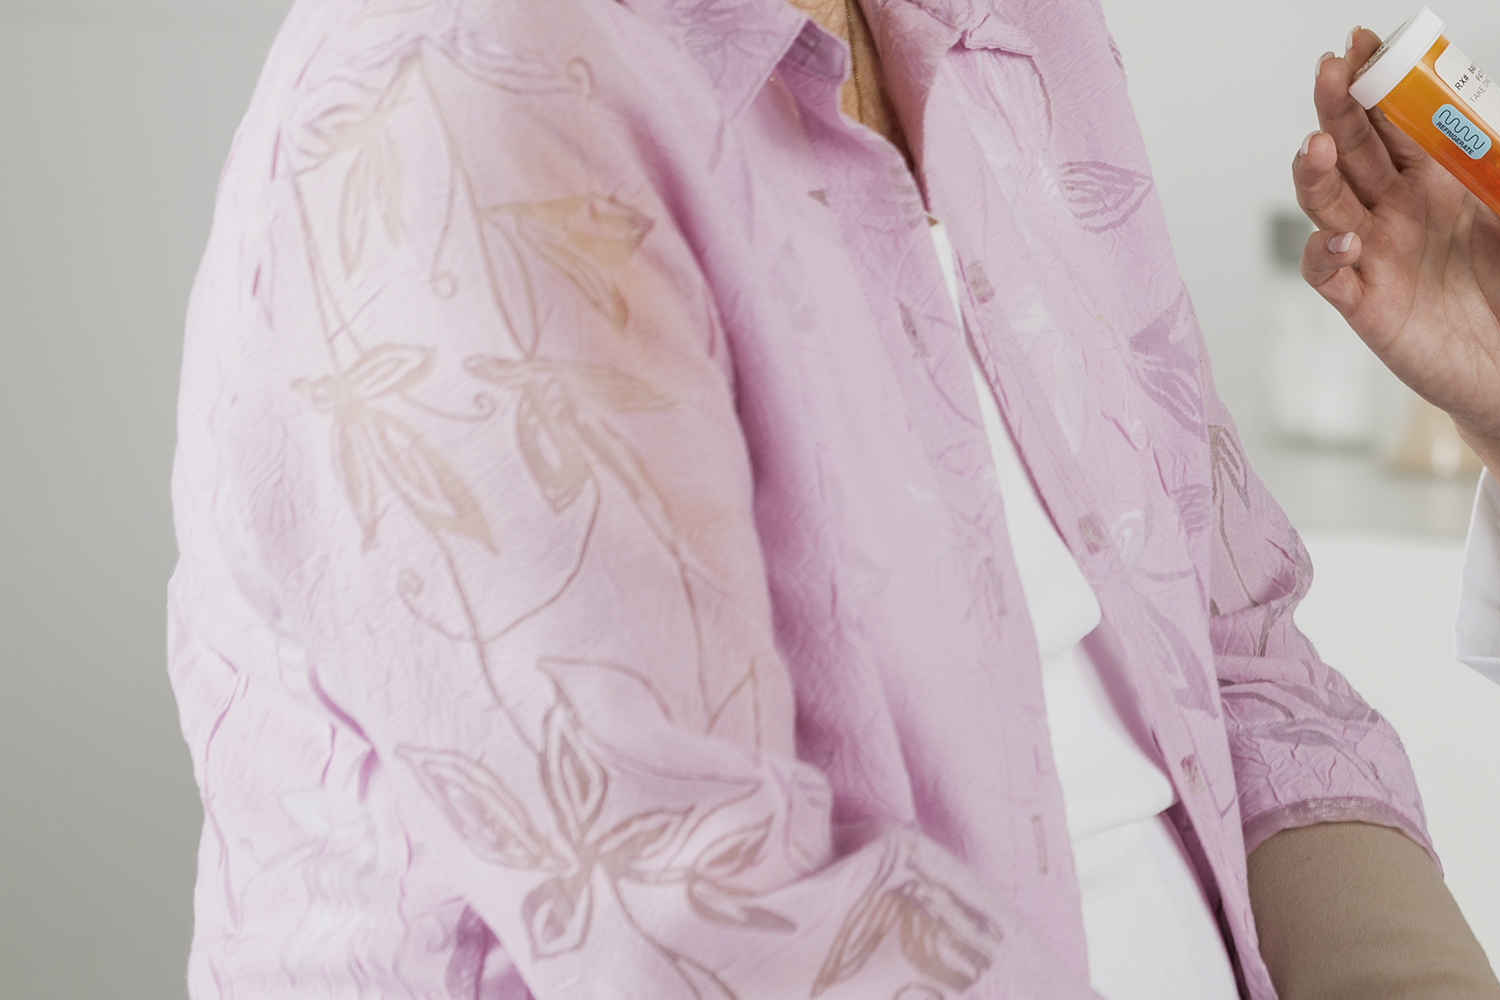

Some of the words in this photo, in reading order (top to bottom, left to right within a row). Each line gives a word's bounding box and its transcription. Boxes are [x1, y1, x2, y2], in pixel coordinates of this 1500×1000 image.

[1455, 74, 1469, 91] RX#
[1469, 86, 1486, 103] TAKE
[1436, 121, 1475, 156] REFRIGERATE
